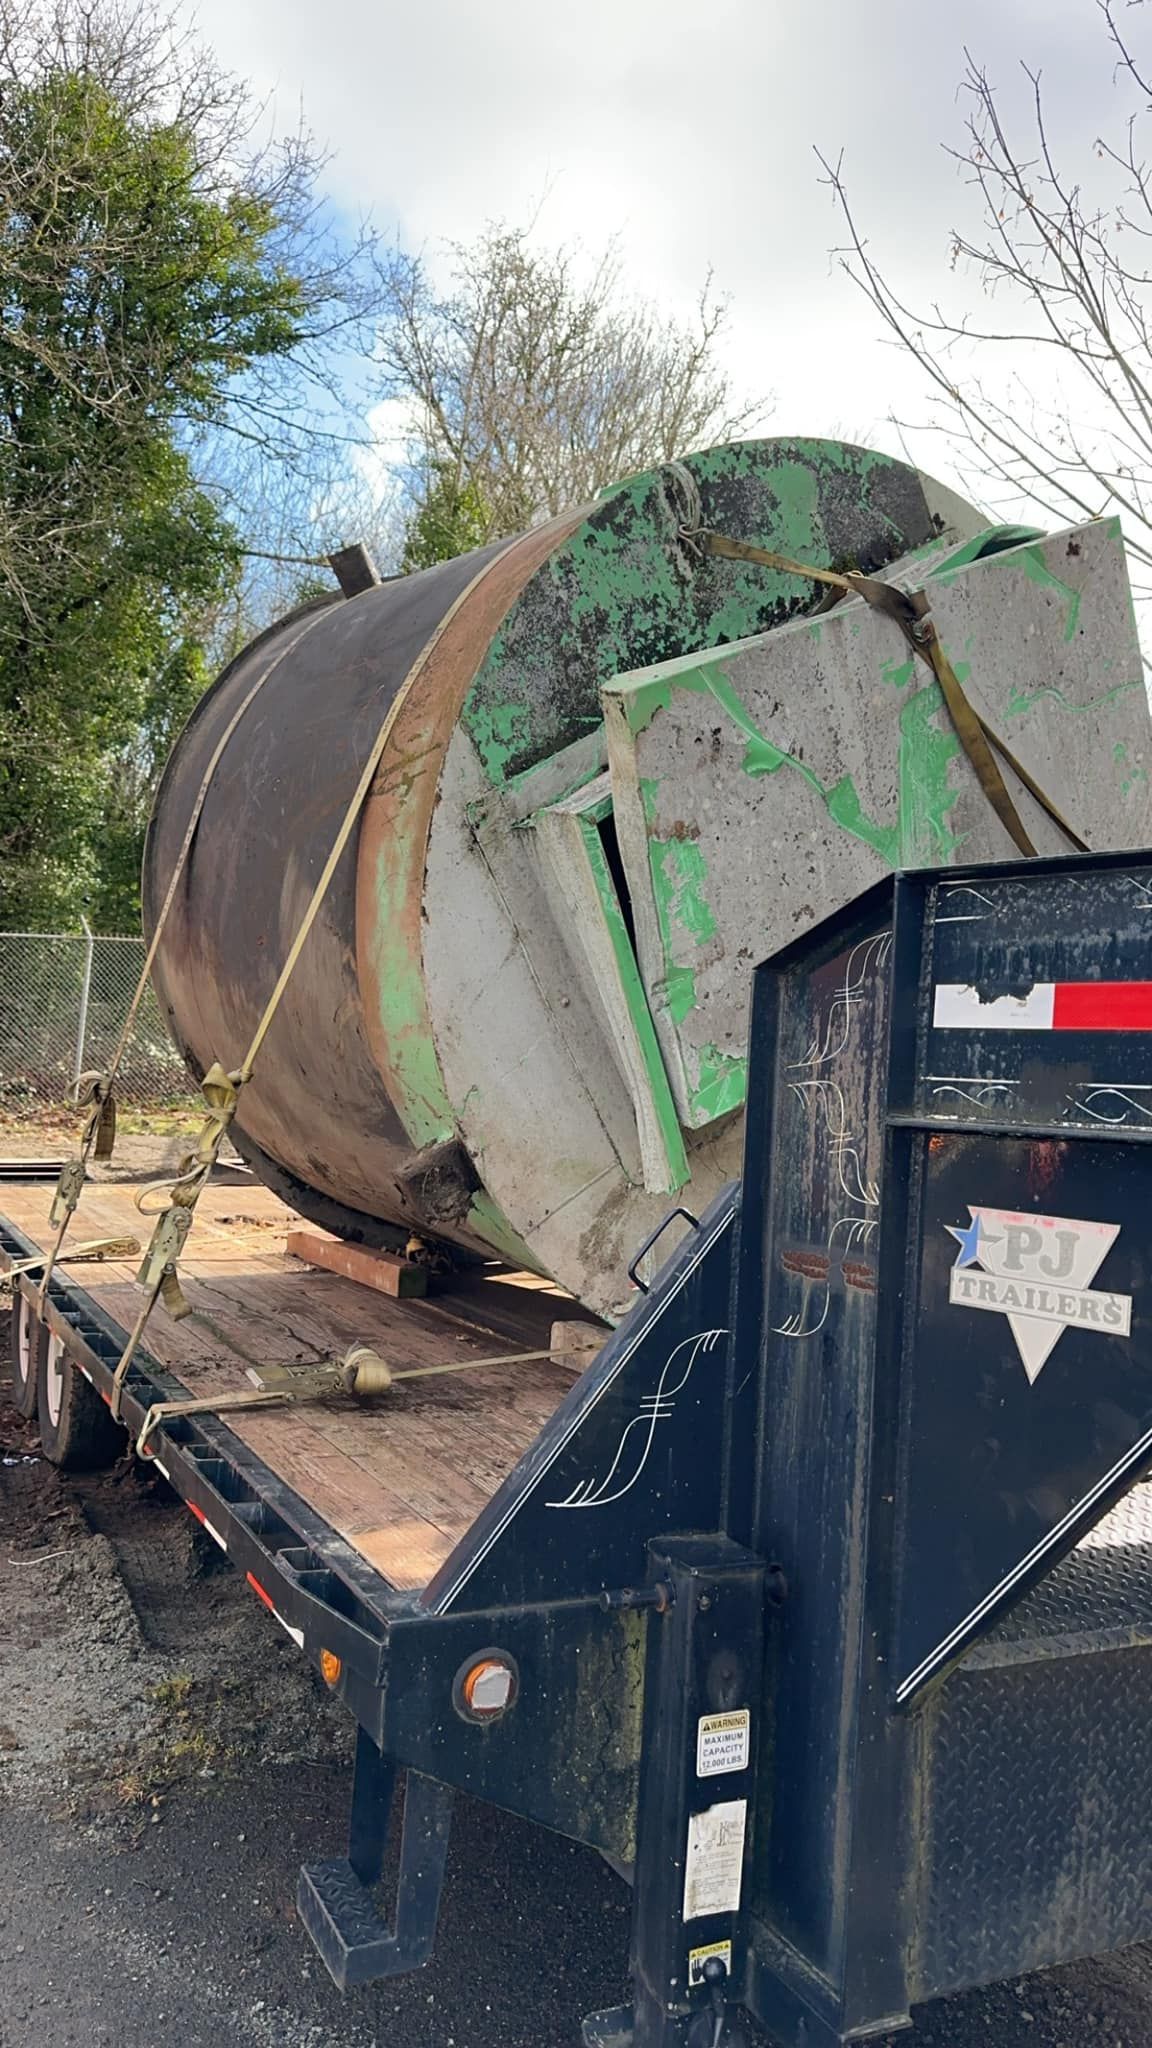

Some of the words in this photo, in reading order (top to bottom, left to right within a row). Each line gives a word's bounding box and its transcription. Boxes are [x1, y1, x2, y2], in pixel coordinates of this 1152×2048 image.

[1002, 1224, 1080, 1278] PJ
[958, 1277, 1122, 1325] TRAILERS
[711, 1716, 746, 1729] WARNING
[704, 1732, 743, 1745] MAXIMUM
[703, 1744, 743, 1757] CAPACITY
